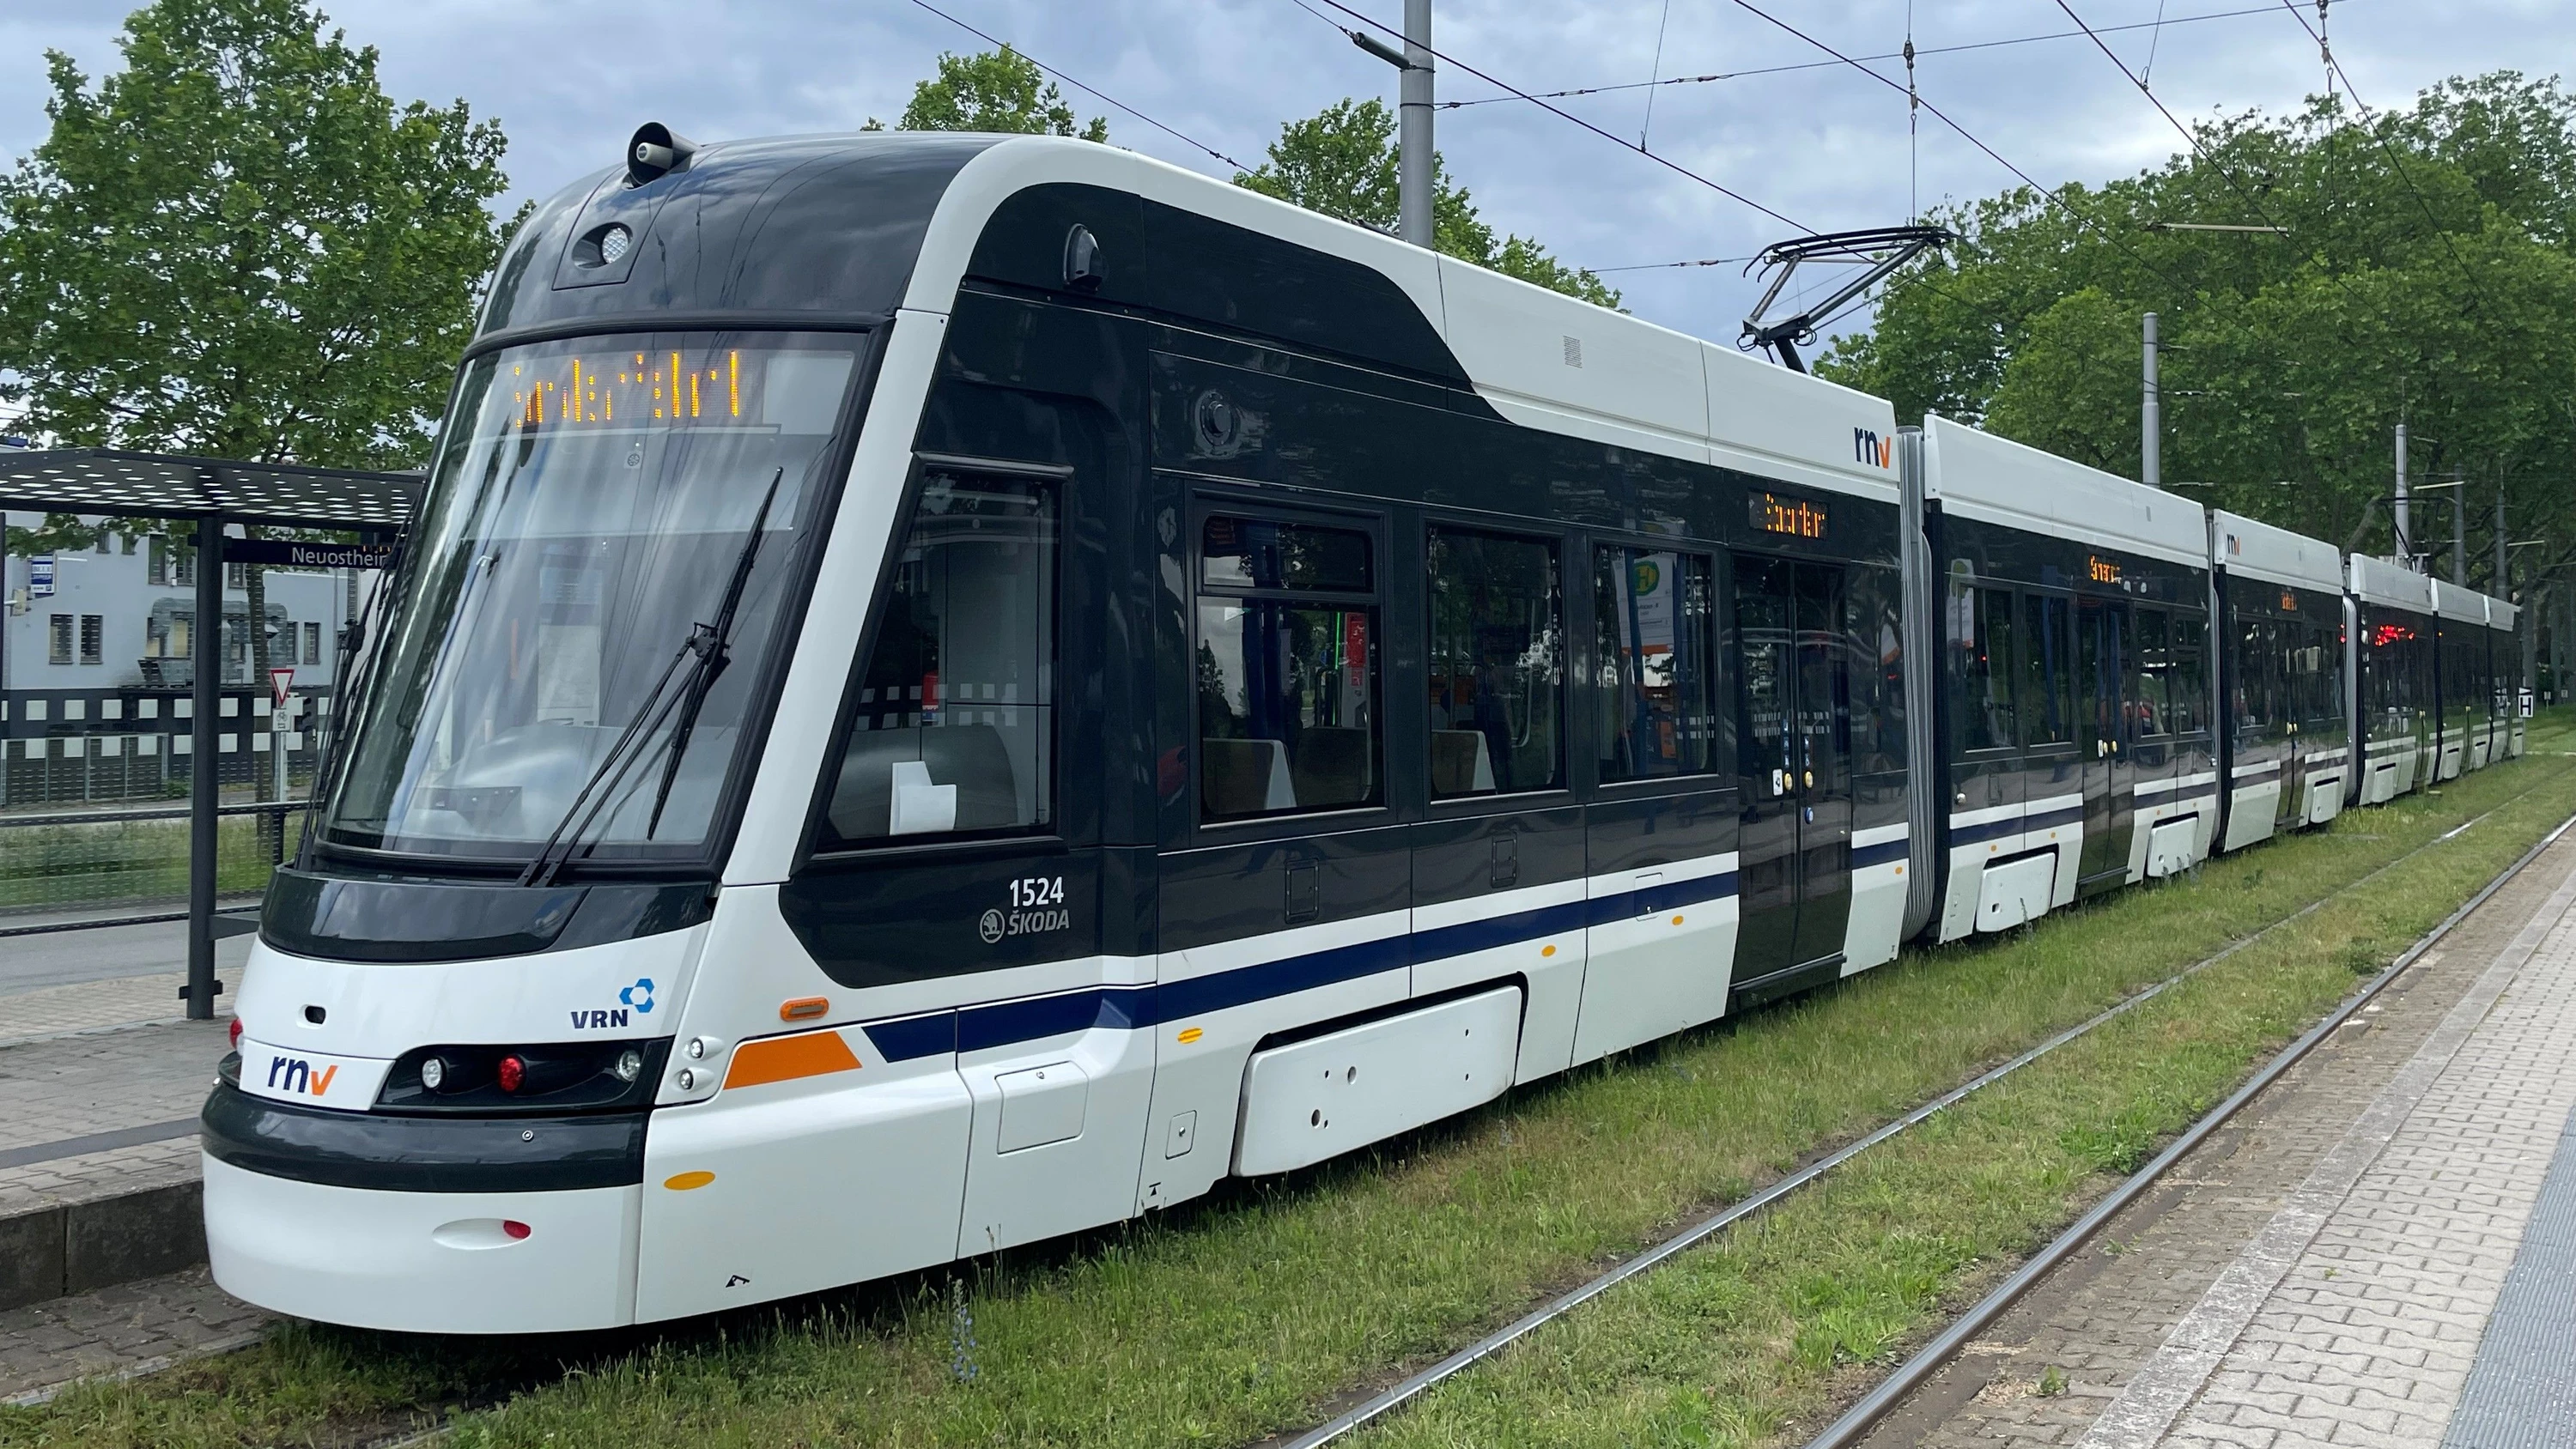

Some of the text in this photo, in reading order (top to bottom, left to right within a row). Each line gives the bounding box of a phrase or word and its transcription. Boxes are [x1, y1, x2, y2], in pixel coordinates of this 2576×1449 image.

[1854, 427, 1891, 469] rnv
[2520, 697, 2531, 715] H
[1010, 876, 1064, 906] 1524
[1007, 910, 1069, 935] ŠKODA
[570, 1009, 628, 1028] VRN
[268, 1056, 338, 1095] rnv
